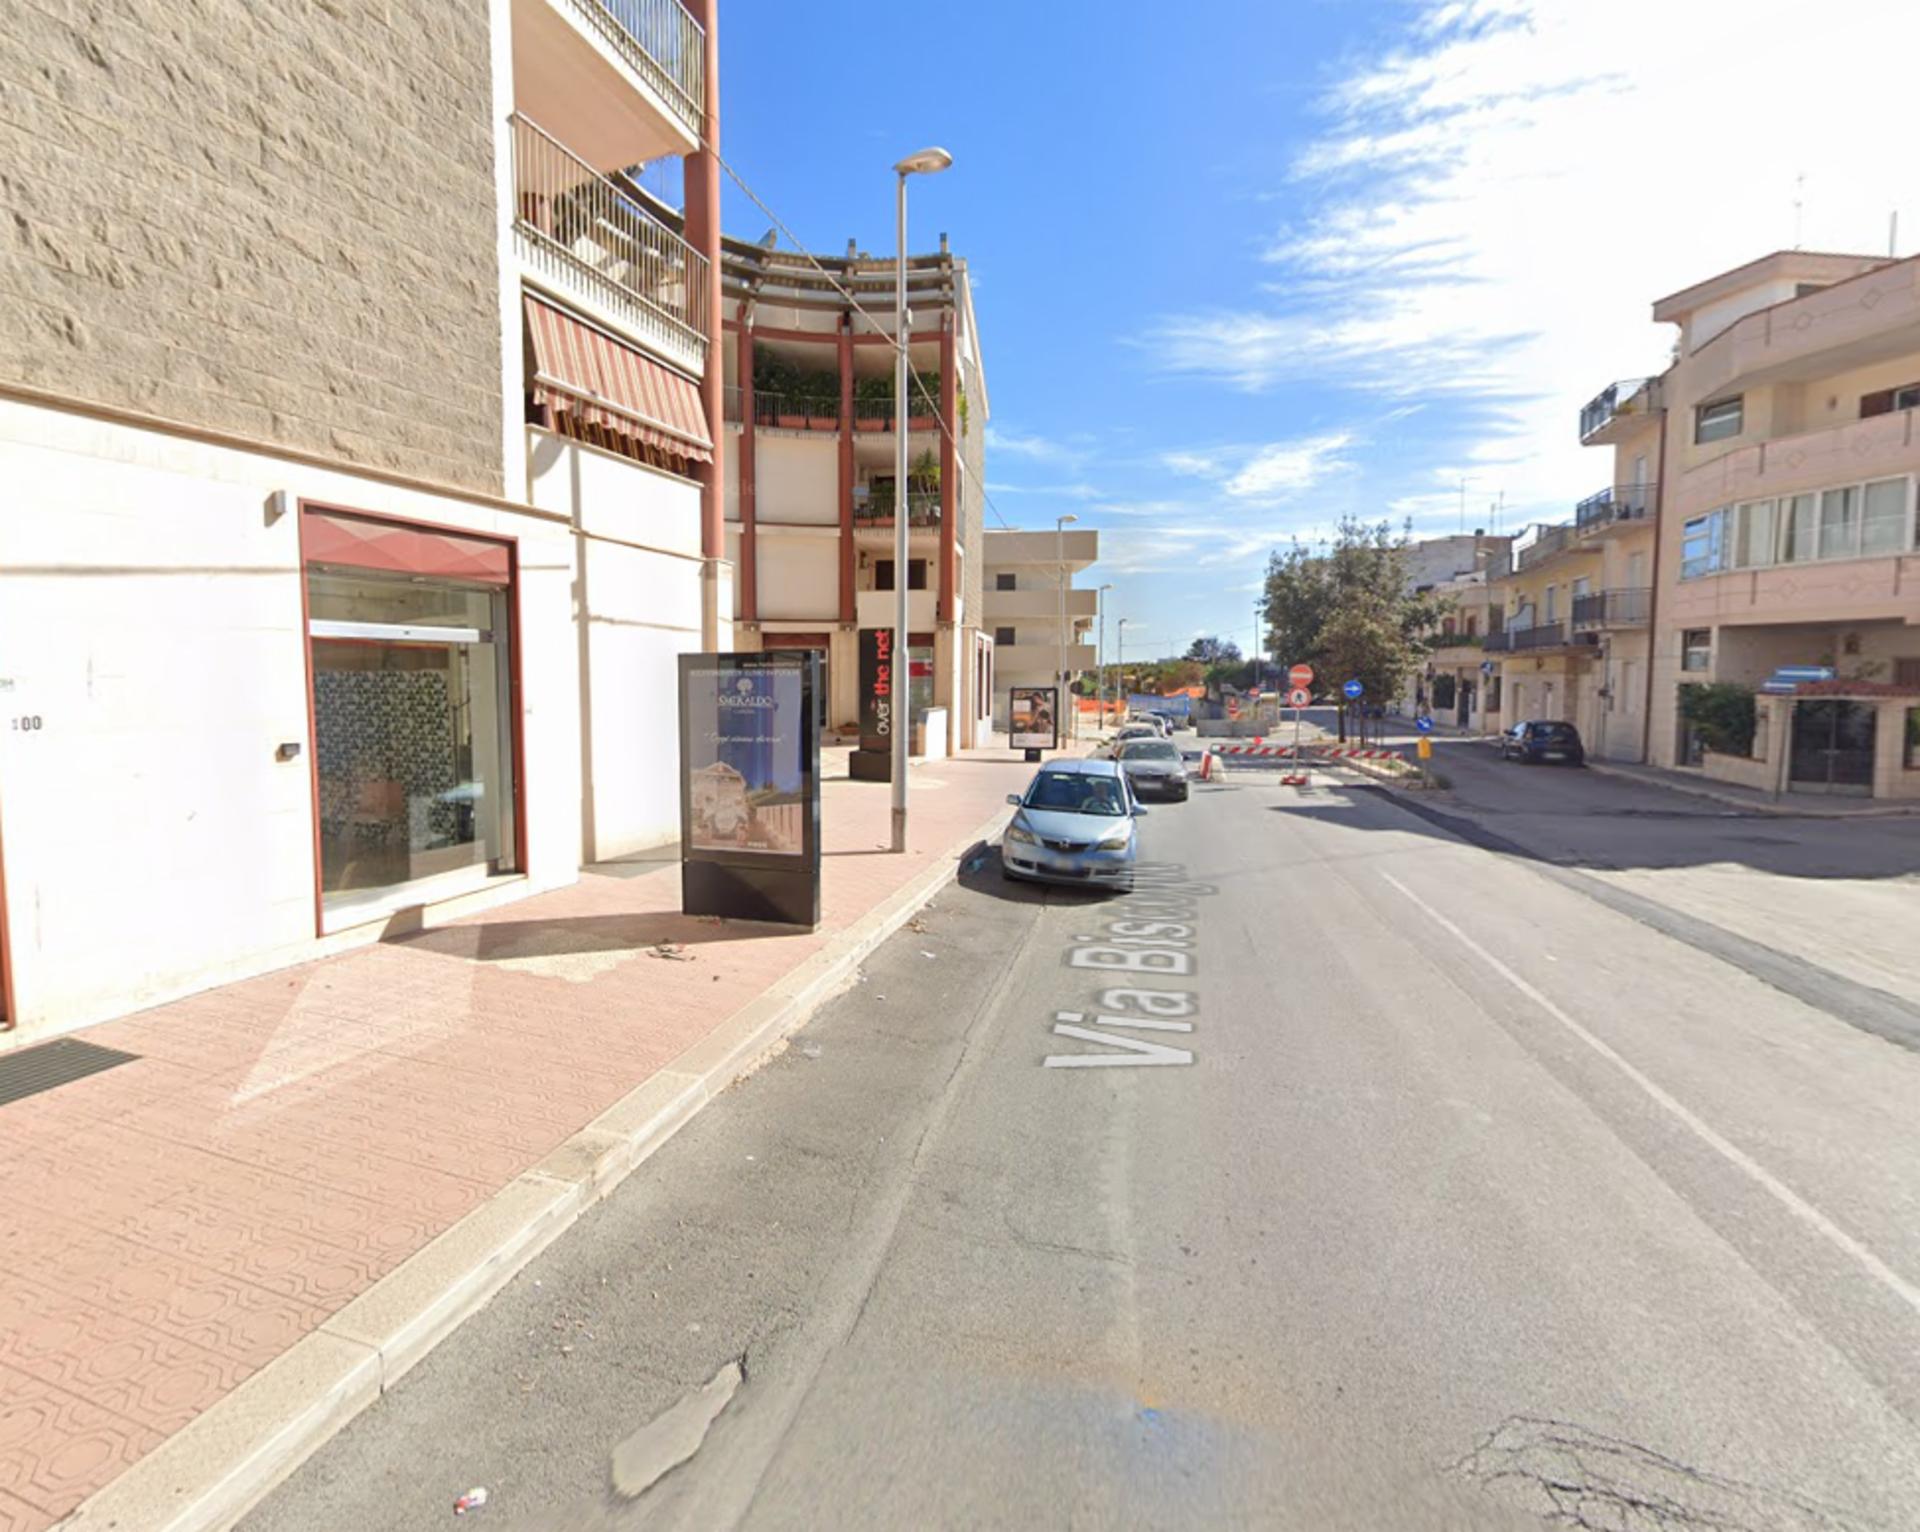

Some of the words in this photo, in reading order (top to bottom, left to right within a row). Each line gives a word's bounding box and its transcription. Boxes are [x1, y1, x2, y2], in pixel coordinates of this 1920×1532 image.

[874, 630, 889, 660] net
[873, 665, 889, 695] the
[876, 700, 889, 736] over
